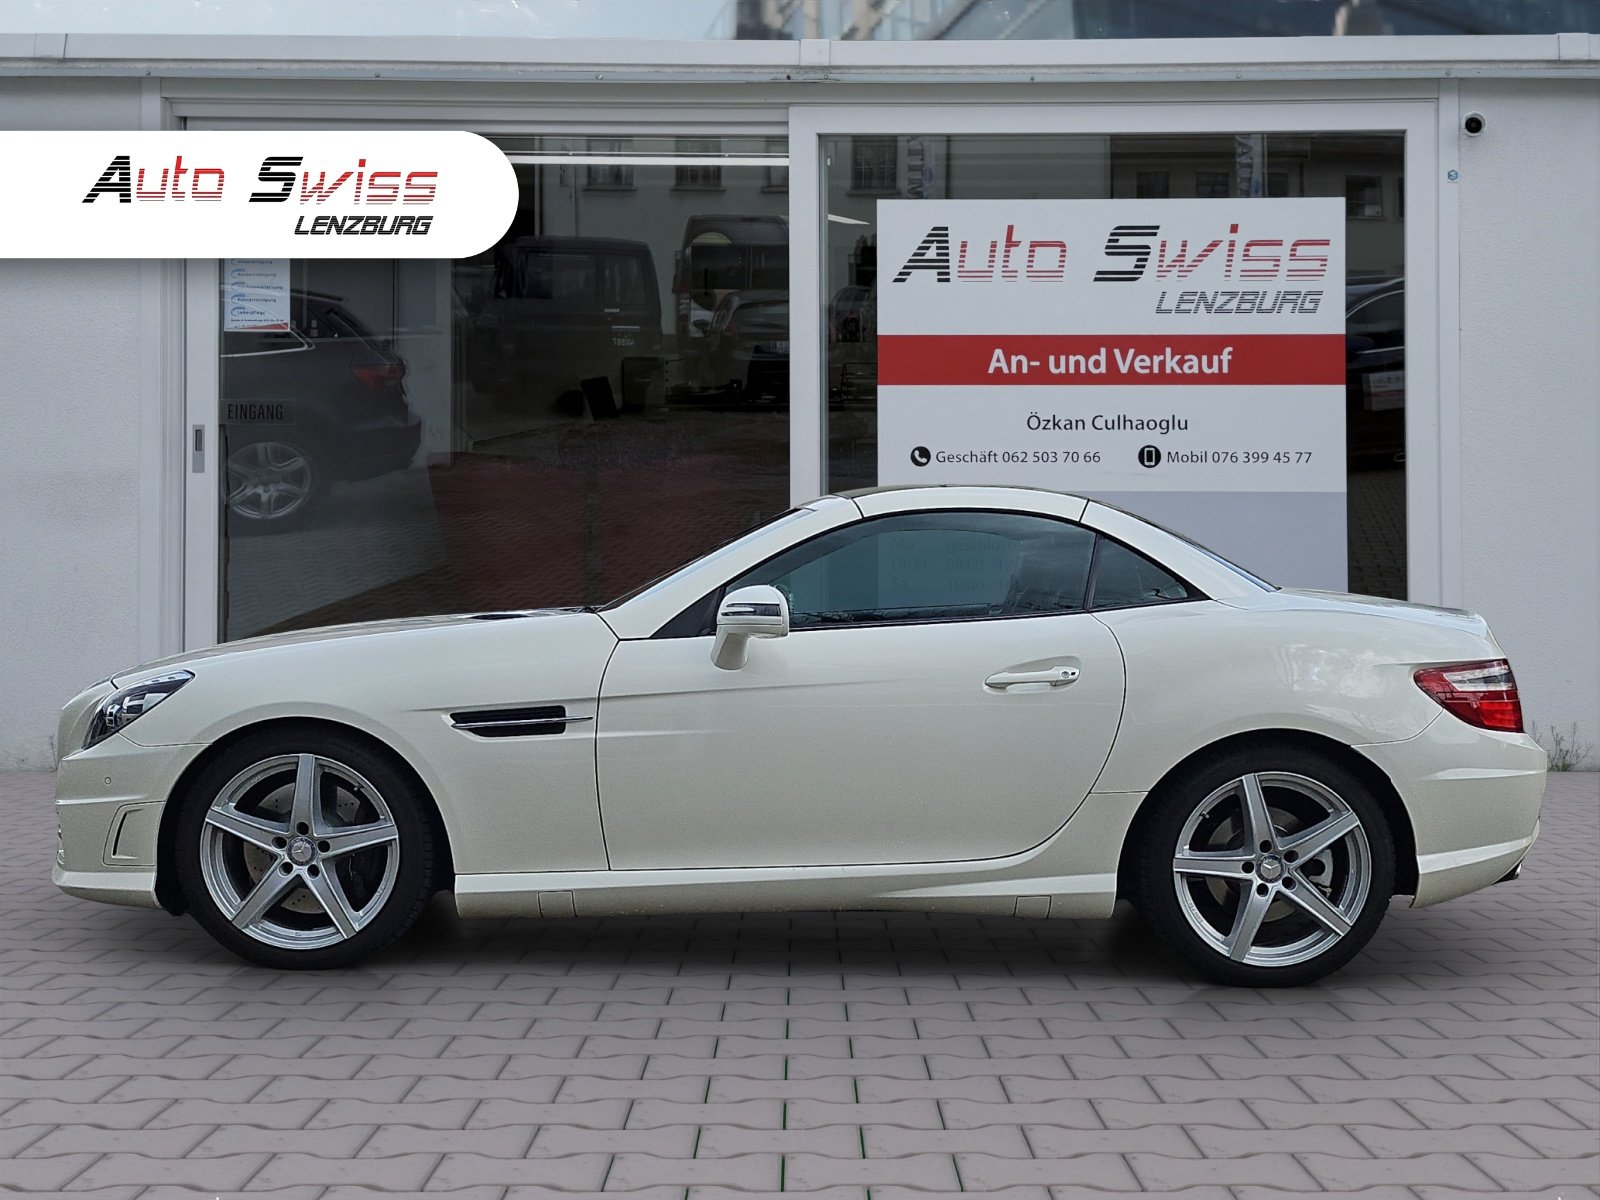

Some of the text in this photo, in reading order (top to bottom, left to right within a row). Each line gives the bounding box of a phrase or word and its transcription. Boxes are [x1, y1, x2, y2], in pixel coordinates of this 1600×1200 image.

[892, 223, 1331, 282] Auto Swiss
[1155, 290, 1324, 314] LENZBURG
[988, 346, 1233, 374] An- und Verkauf
[227, 403, 283, 420] EINGANG
[1026, 411, 1189, 435] Özkan Culhaoglu
[935, 450, 1101, 463] Geschäft 062 503 70 66
[1166, 450, 1313, 464] Mobil 076 399 45 77
[891, 537, 915, 550] Mo
[891, 577, 908, 590] Sa
